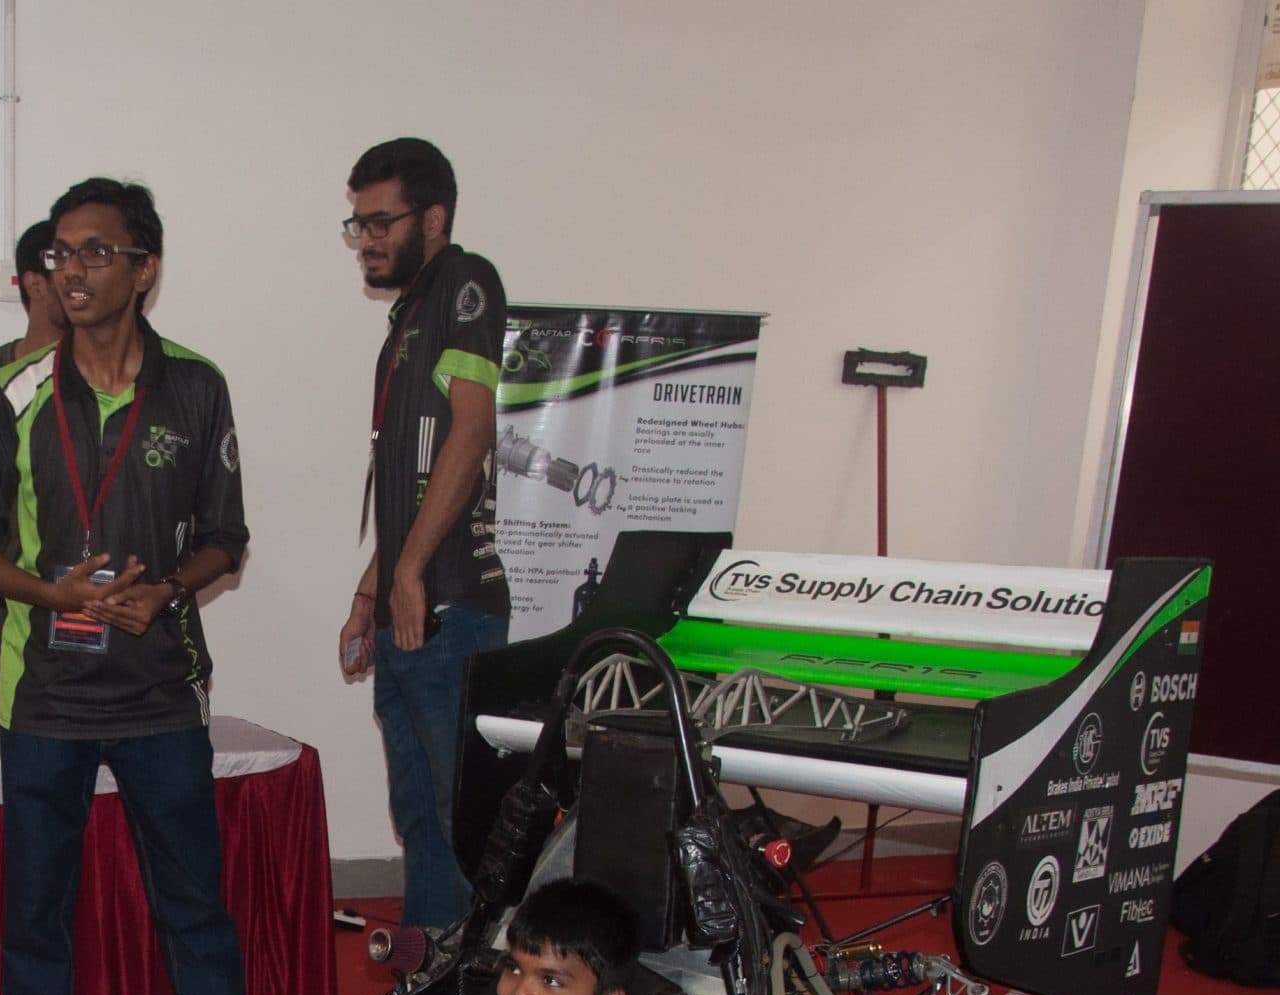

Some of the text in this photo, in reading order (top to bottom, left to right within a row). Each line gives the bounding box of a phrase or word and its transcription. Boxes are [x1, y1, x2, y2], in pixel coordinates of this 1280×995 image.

[653, 383, 743, 405] DRIVETRAIN
[637, 417, 688, 428] Redesigned
[691, 420, 718, 428] Wheel
[636, 427, 670, 438] Bearings
[689, 439, 702, 447] the
[632, 465, 724, 477] Drastically reduced the
[631, 476, 670, 484] resistance
[684, 478, 716, 486] rotation
[636, 504, 666, 513] positive
[627, 512, 672, 522] mechanism
[504, 519, 536, 529] Shifting
[730, 572, 772, 589] TVS
[775, 572, 884, 604] Supply
[889, 580, 983, 608] Chain
[1151, 673, 1199, 703] BOSCH
[1150, 727, 1170, 749] TVS
[1130, 779, 1183, 816] MRF
[1138, 821, 1171, 849] EXIDE
